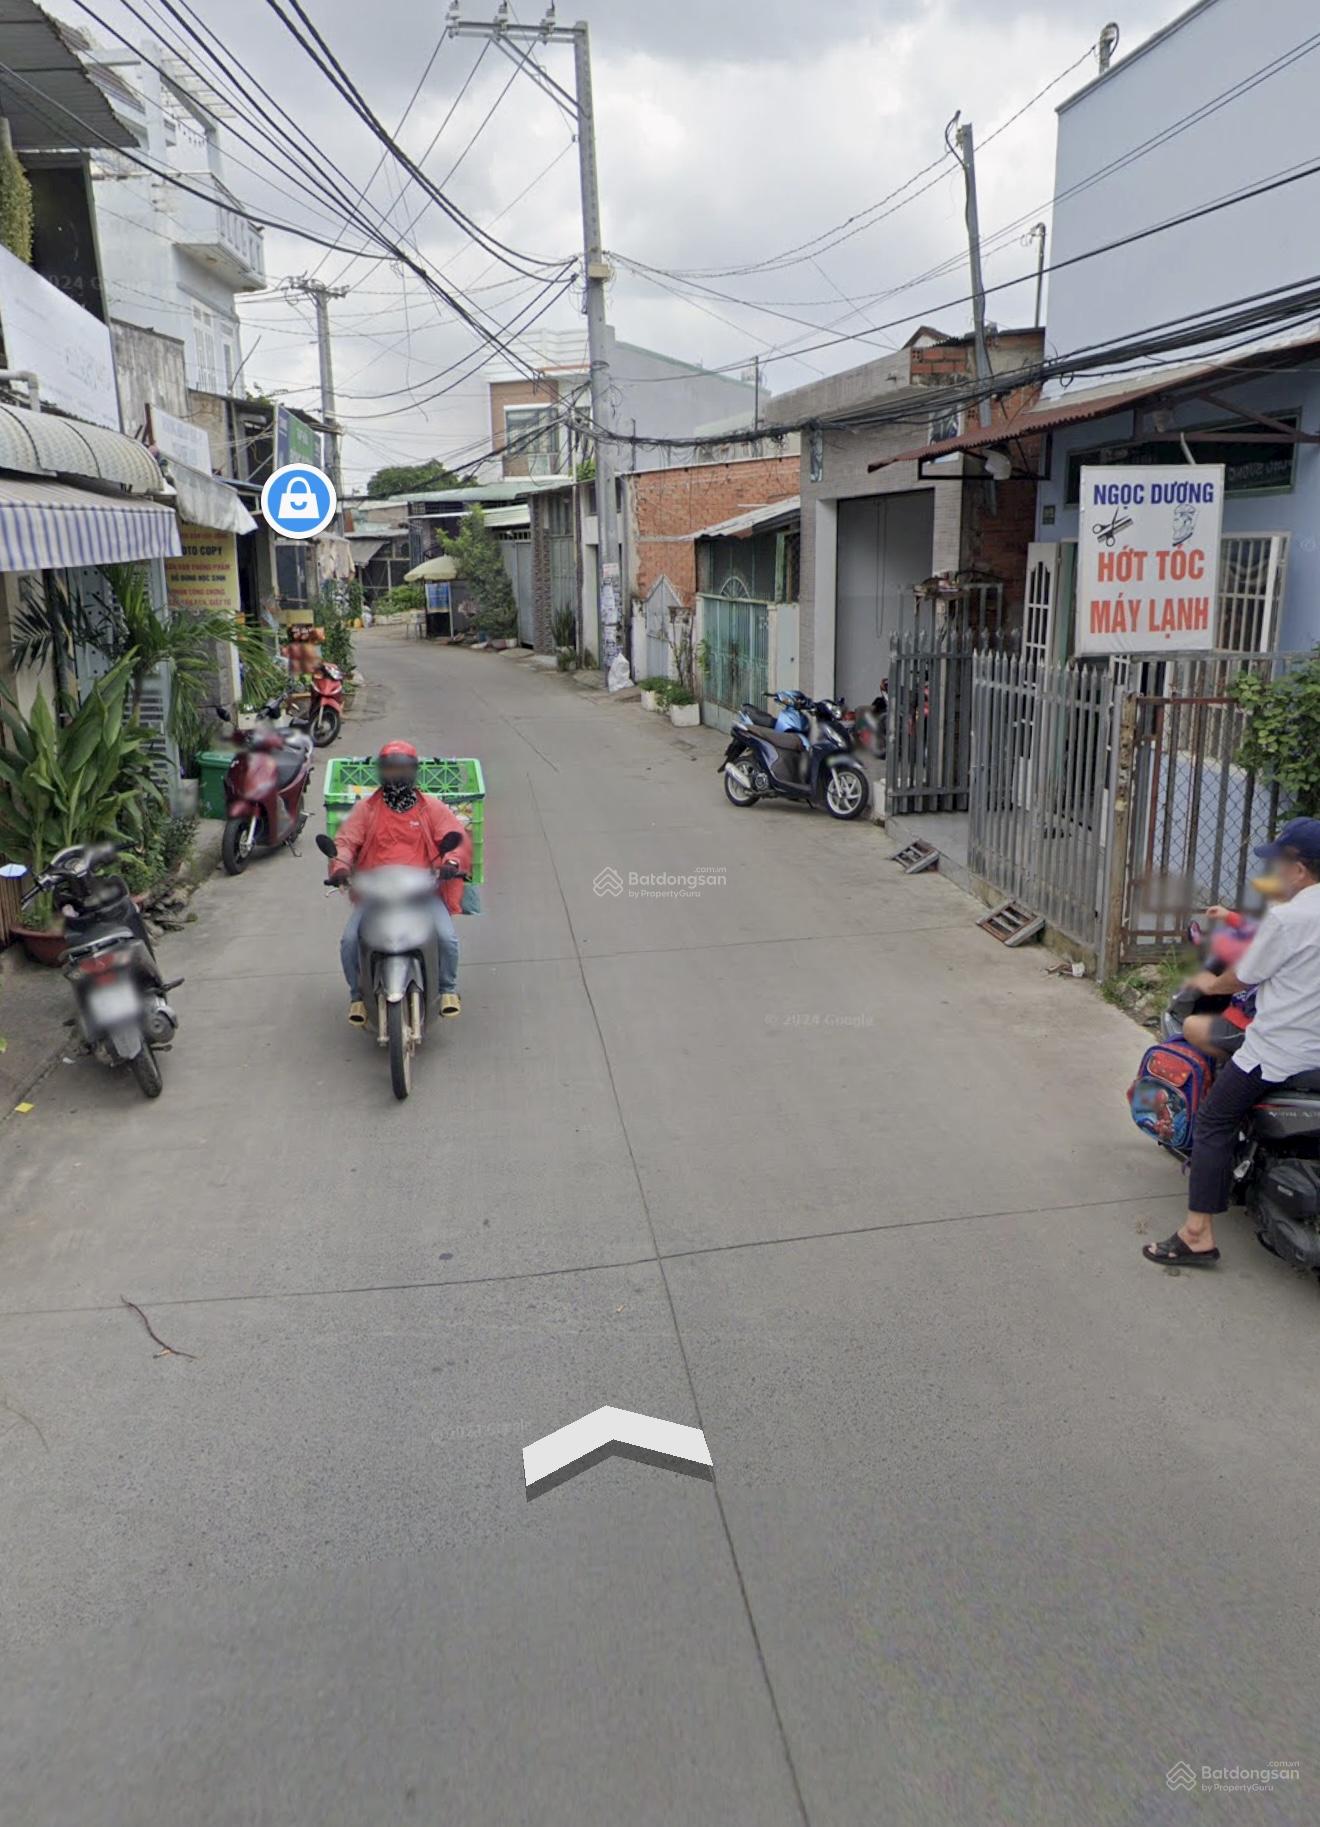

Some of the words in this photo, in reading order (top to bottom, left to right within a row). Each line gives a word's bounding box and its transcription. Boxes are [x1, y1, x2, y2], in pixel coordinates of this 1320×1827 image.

[1093, 484, 1145, 510] NGỌC
[1151, 480, 1214, 505] DƯƠNG
[183, 545, 198, 556] OTO
[1097, 544, 1148, 582] HỚT
[1155, 543, 1205, 581] TÓC
[1090, 592, 1142, 634] MÁY
[1148, 597, 1209, 639] LẠNH
